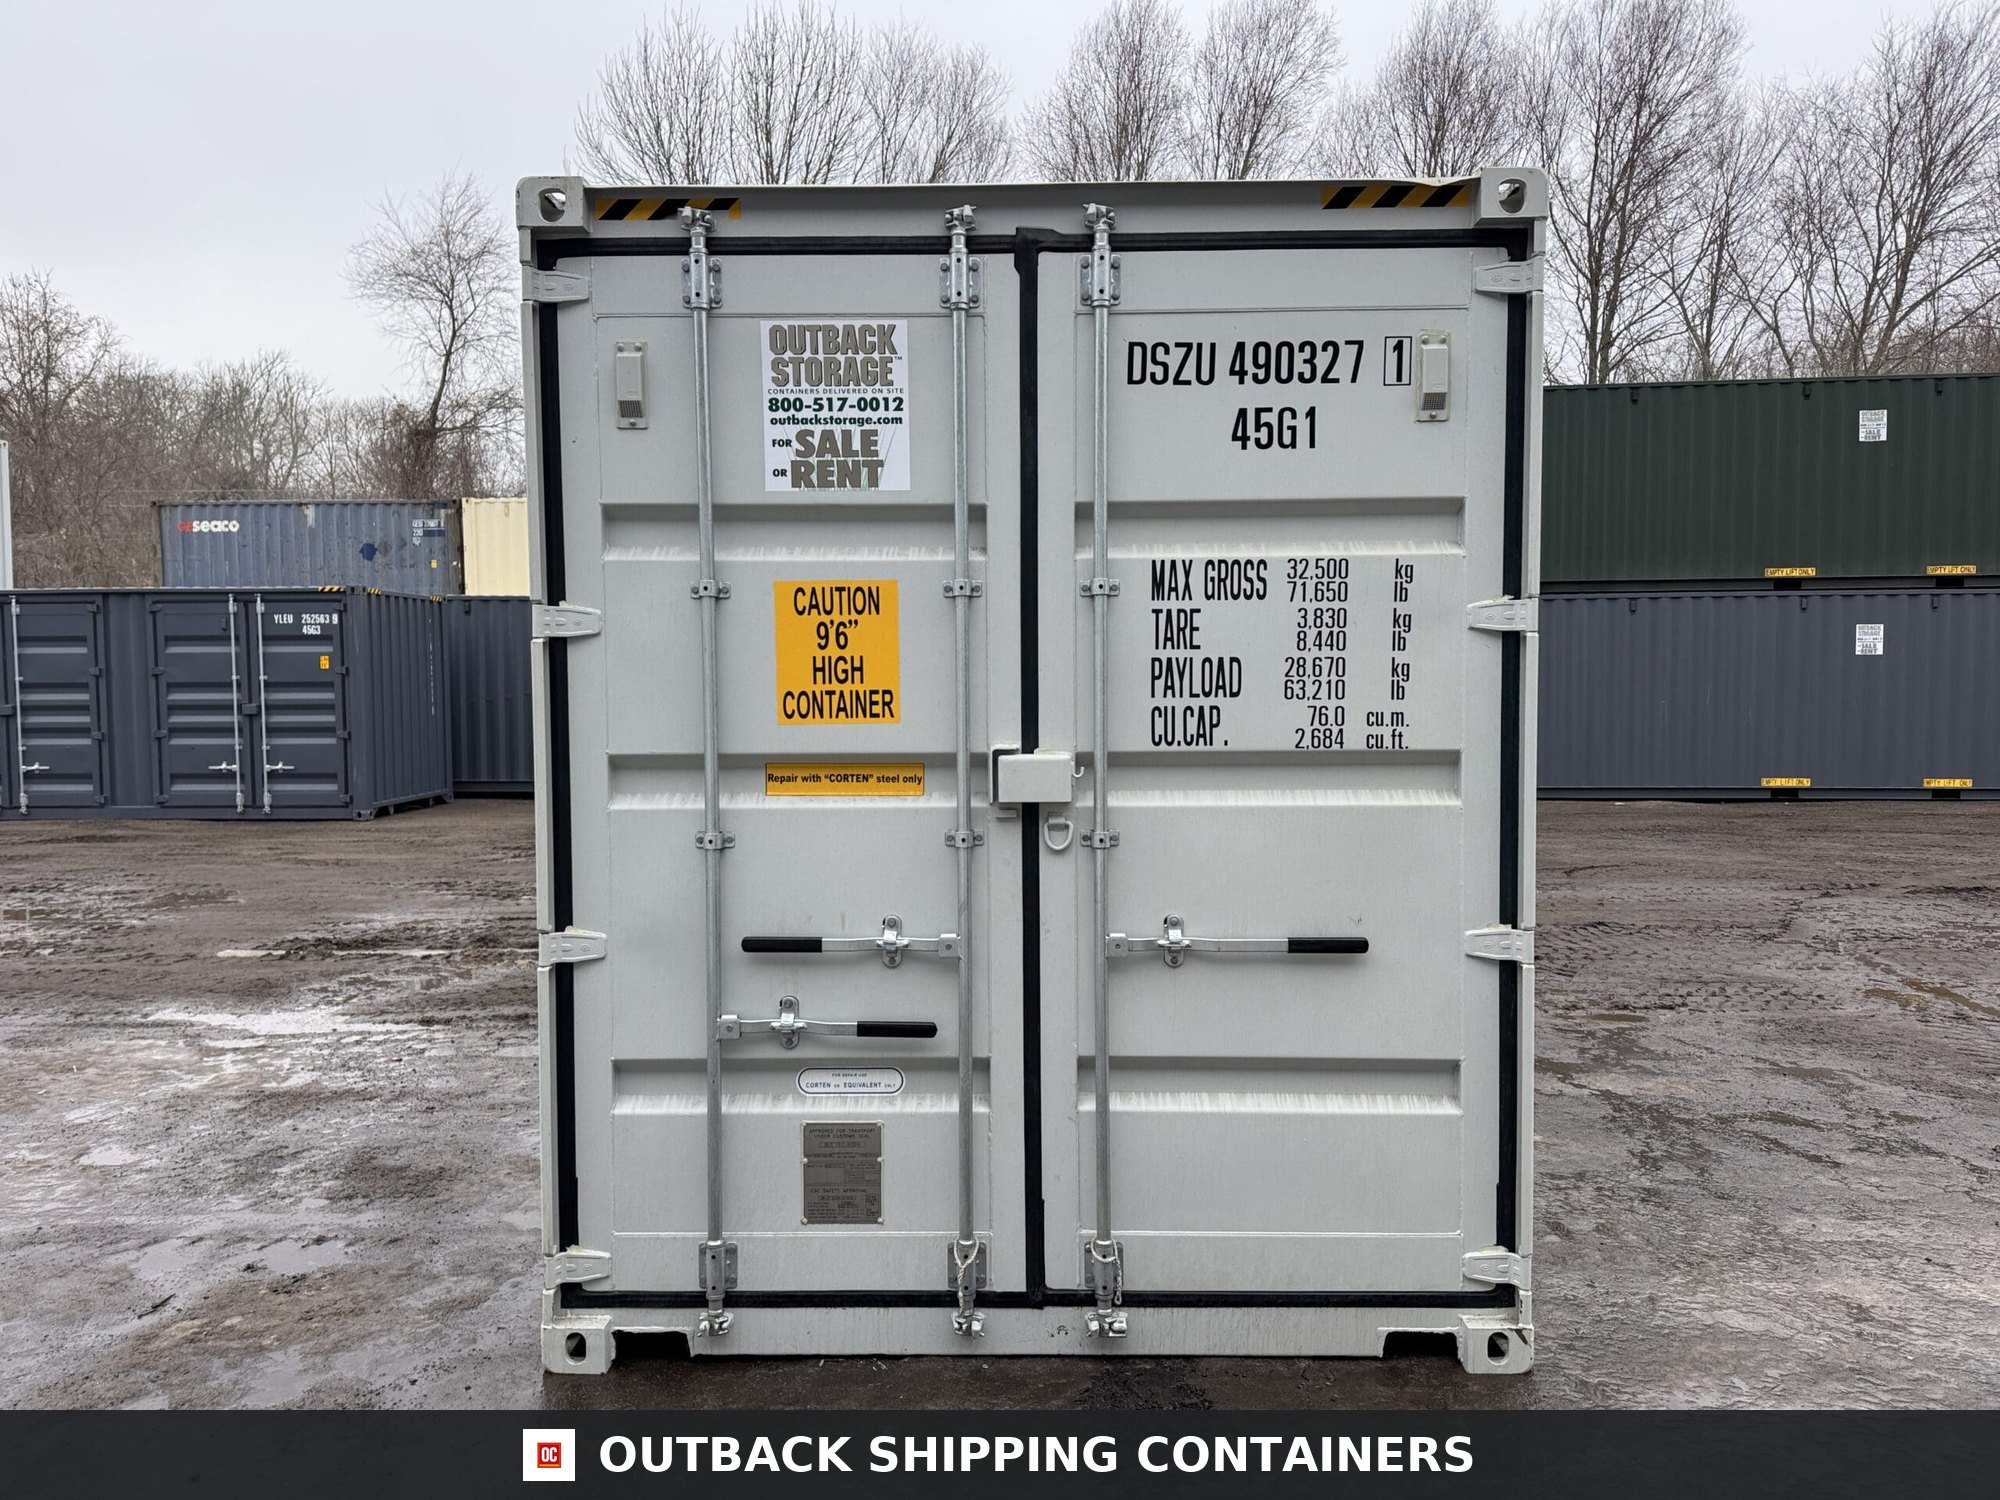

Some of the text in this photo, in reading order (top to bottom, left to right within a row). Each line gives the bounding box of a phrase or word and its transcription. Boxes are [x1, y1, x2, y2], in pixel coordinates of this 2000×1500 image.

[769, 324, 898, 355] OUTBACK
[1127, 339, 1404, 386] DSZU 490327 1
[768, 397, 904, 412] 800-517-0012
[770, 414, 903, 427] outbackstorage.com
[1231, 406, 1316, 450] 45G1
[772, 429, 879, 458] FOR SALE
[772, 459, 884, 488] OR RENT
[1151, 558, 1267, 601] MAX GROSS
[1286, 558, 1414, 584] 32,500 kg
[794, 586, 880, 616] CAUTION
[1287, 581, 1408, 603] 71,650 lb
[274, 614, 294, 624] YLEU
[301, 614, 330, 624] 252563
[302, 625, 321, 635] 45G3
[1151, 608, 1201, 650] TARE
[1297, 608, 1412, 633] 3,830 kg
[1296, 630, 1406, 652] 8,440 lb
[812, 655, 864, 685] HIGH
[1151, 656, 1242, 699] PAYLOAD
[1284, 656, 1410, 682] 28,670 kg
[783, 689, 895, 719] CONTAINER
[1284, 680, 1405, 702] 63,210 lb
[1307, 706, 1410, 728] 76.0 cu.m.
[1295, 728, 1409, 750] 2,684 cu.ft.
[768, 774, 798, 785] Repair
[801, 774, 821, 783] with
[876, 774, 900, 783] steel
[902, 774, 922, 785] only
